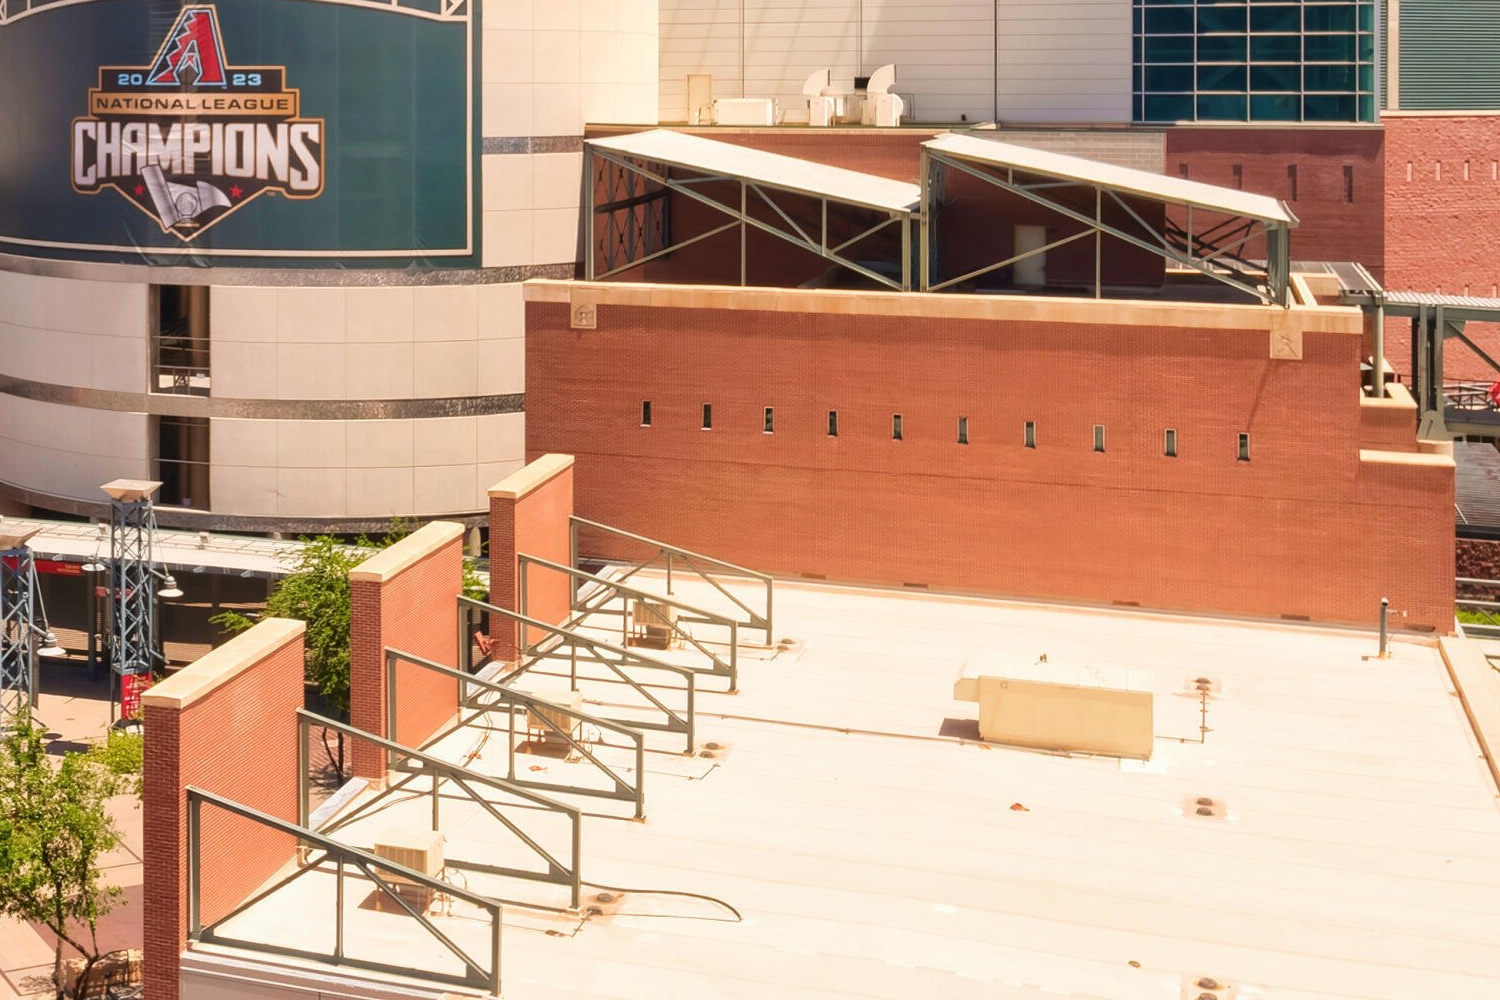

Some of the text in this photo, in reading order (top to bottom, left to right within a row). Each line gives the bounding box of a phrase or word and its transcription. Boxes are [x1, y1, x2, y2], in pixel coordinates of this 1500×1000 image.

[117, 73, 262, 86] 20 23
[96, 98, 289, 110] NATIONAL LEAGUE
[74, 120, 320, 191] CHAMPIONS
